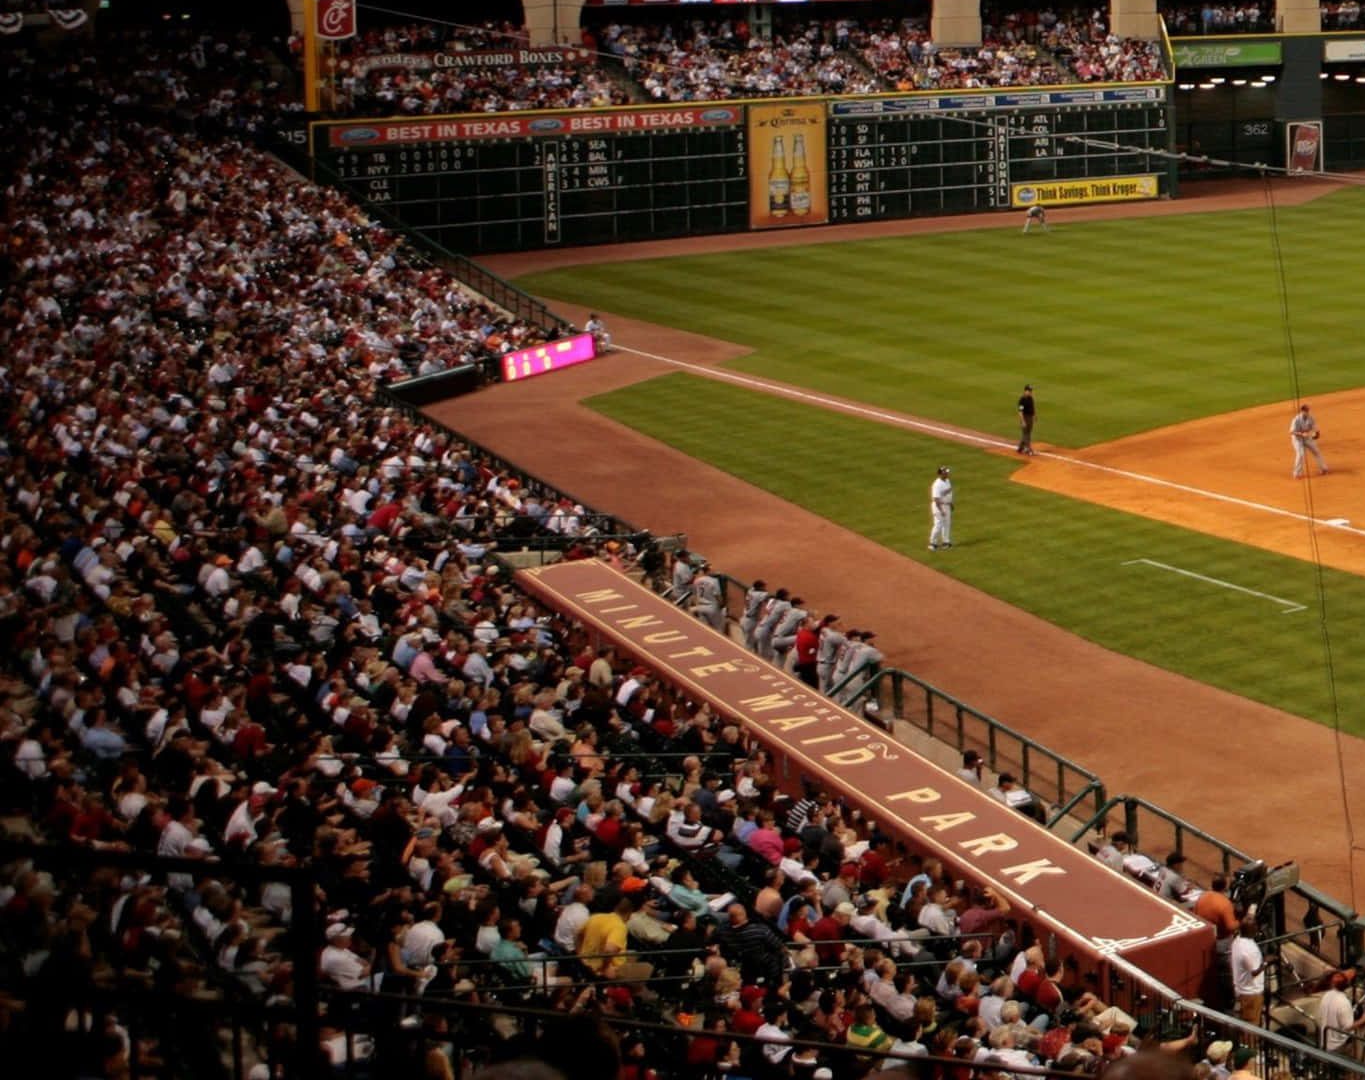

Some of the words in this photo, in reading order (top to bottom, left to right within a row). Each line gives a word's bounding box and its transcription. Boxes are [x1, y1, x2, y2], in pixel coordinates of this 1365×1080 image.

[434, 51, 513, 68] CRAWFORD
[519, 50, 563, 64] BOXES
[387, 125, 432, 140] BEST
[438, 124, 457, 137] IN
[464, 120, 521, 136] TEXAS
[570, 116, 611, 131] BEST
[617, 114, 635, 128] IN
[640, 111, 694, 127] TEXAS
[1243, 123, 1269, 136] 362
[998, 126, 1006, 196] NATIONAL
[546, 153, 557, 231] AMERICAN
[1037, 186, 1057, 200] Think
[1091, 183, 1110, 197] Think
[1112, 182, 1137, 196] Kroger
[759, 674, 842, 722] WELCOME
[845, 727, 871, 741] TO
[574, 589, 738, 679] MINUTE
[739, 693, 876, 765] MAID
[885, 786, 1066, 887] PARK
